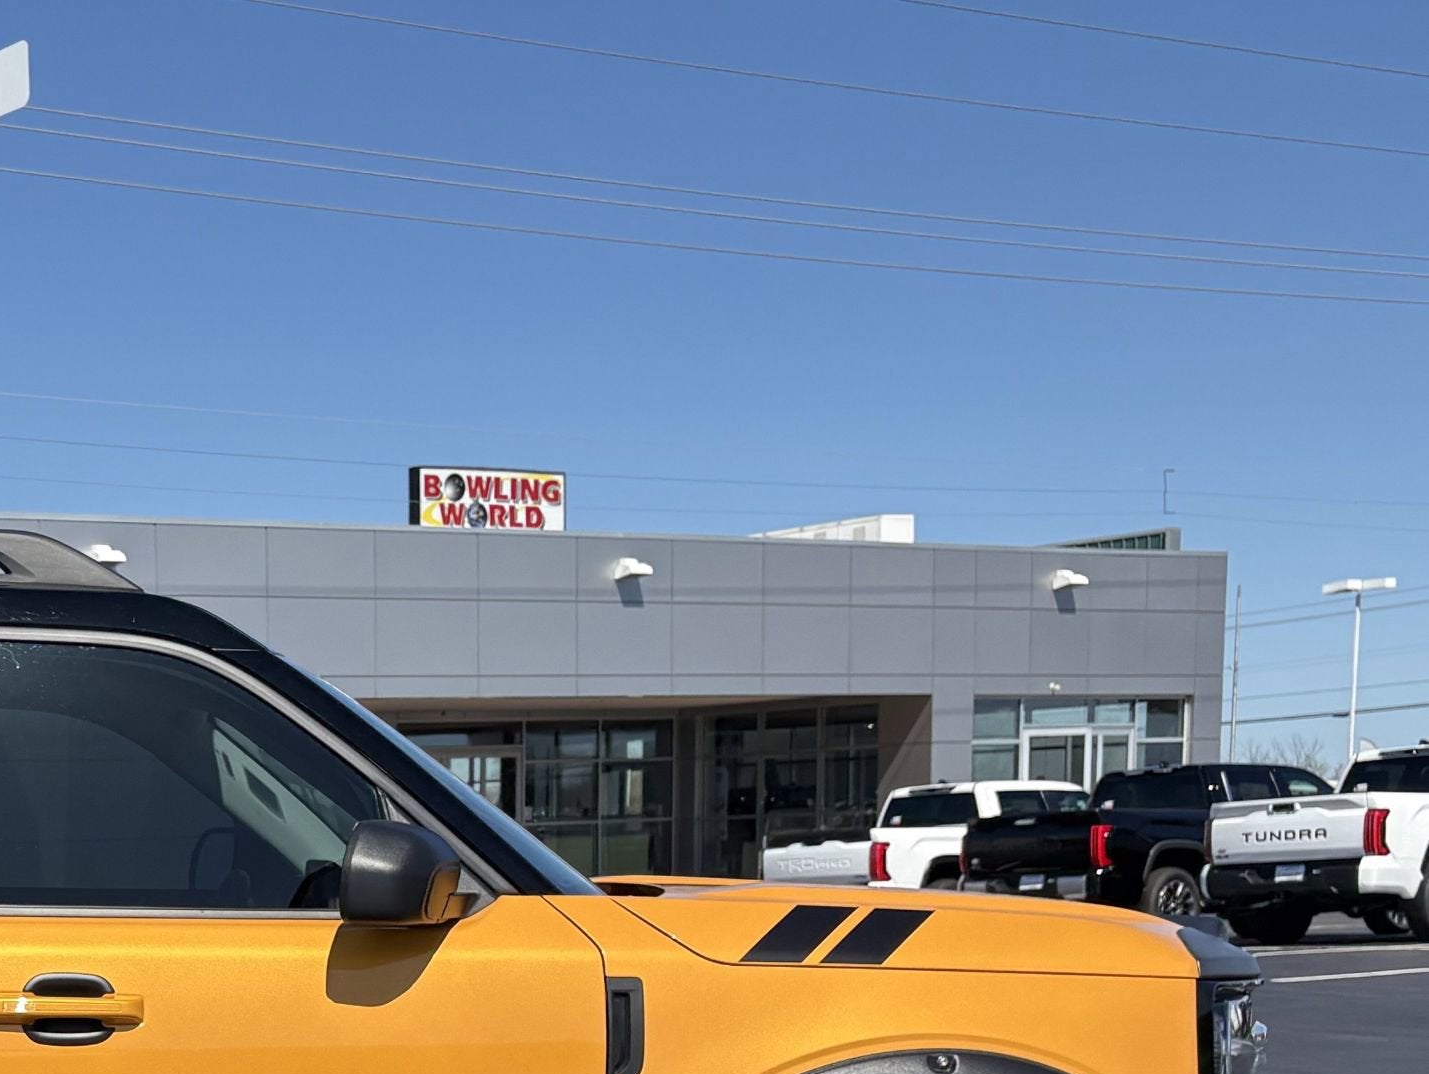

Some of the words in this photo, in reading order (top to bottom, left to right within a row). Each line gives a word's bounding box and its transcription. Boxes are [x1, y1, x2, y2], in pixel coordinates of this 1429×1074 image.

[424, 473, 561, 504] BOWLING
[439, 501, 544, 528] WORLD
[1242, 828, 1328, 843] TUNDRA
